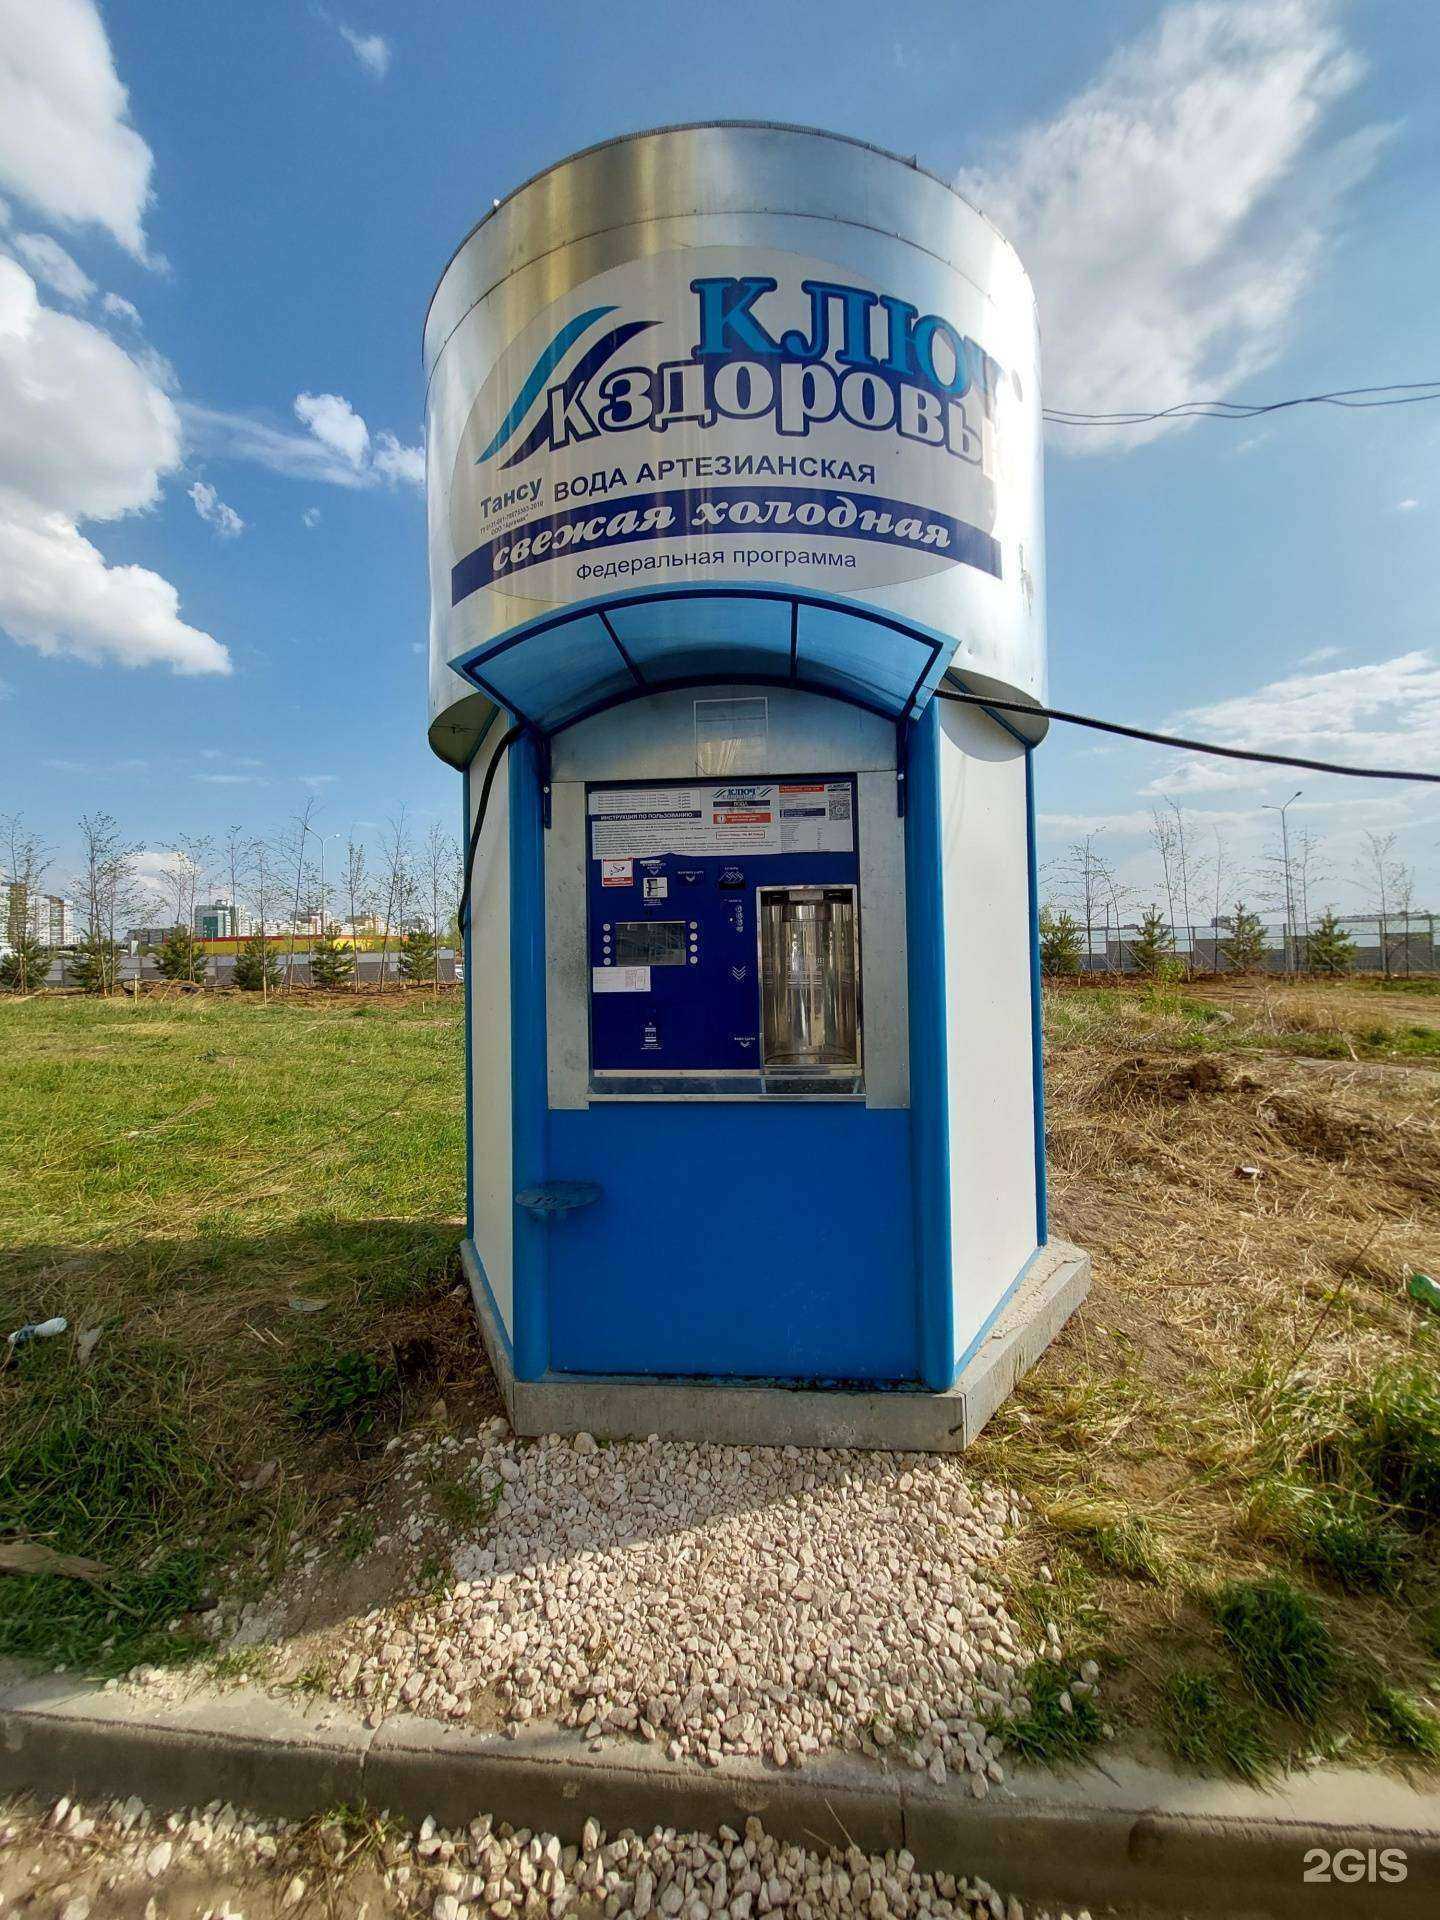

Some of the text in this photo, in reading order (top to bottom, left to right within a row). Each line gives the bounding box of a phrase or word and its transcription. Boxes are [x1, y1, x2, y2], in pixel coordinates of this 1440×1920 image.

[480, 477, 542, 519] Тансу
[554, 455, 876, 502] ВОДА АРТЕЗИАНСКАЯ
[492, 495, 953, 572] свежая холодная
[576, 549, 857, 581] Федеральная программа
[648, 811, 694, 820] ПОЛЬЗОВАНИЮ
